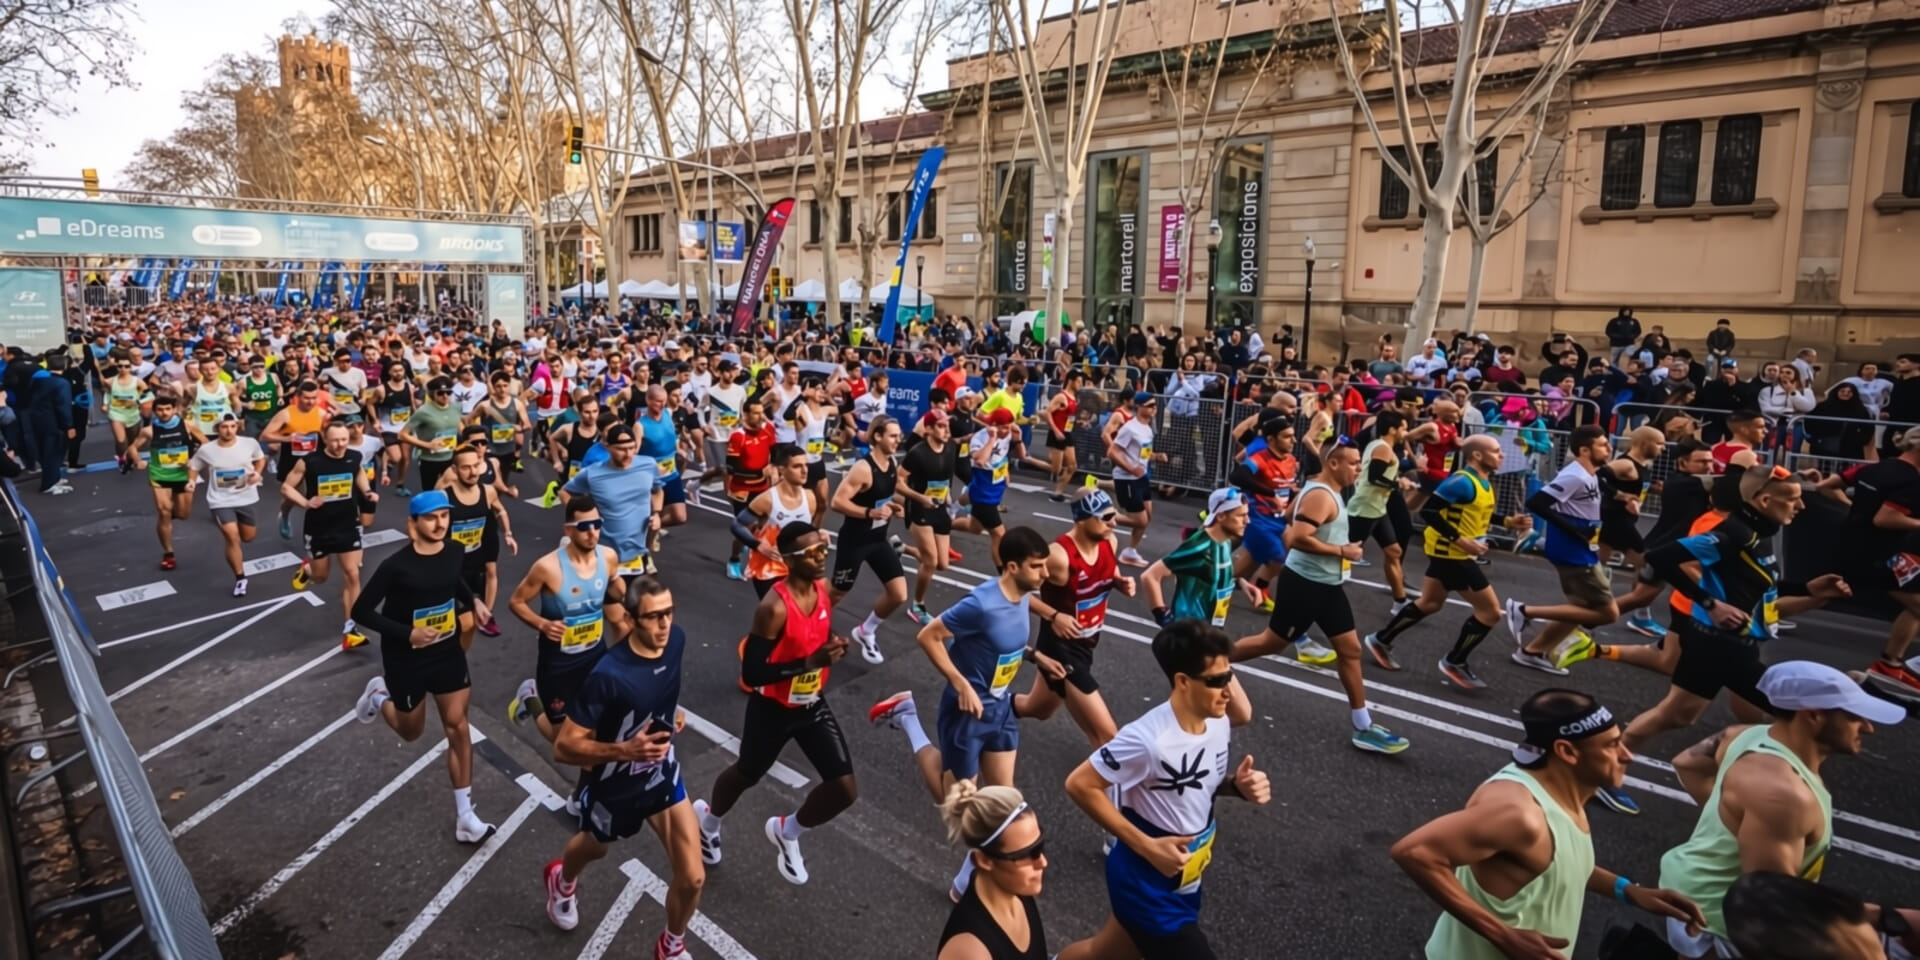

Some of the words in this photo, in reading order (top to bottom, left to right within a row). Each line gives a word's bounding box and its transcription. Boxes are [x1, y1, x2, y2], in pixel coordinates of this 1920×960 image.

[67, 219, 165, 239] eDreams
[439, 237, 505, 252] BROOKS
[1120, 213, 1135, 292] martorell
[1239, 181, 1259, 293] exposicions
[1014, 240, 1026, 292] centre
